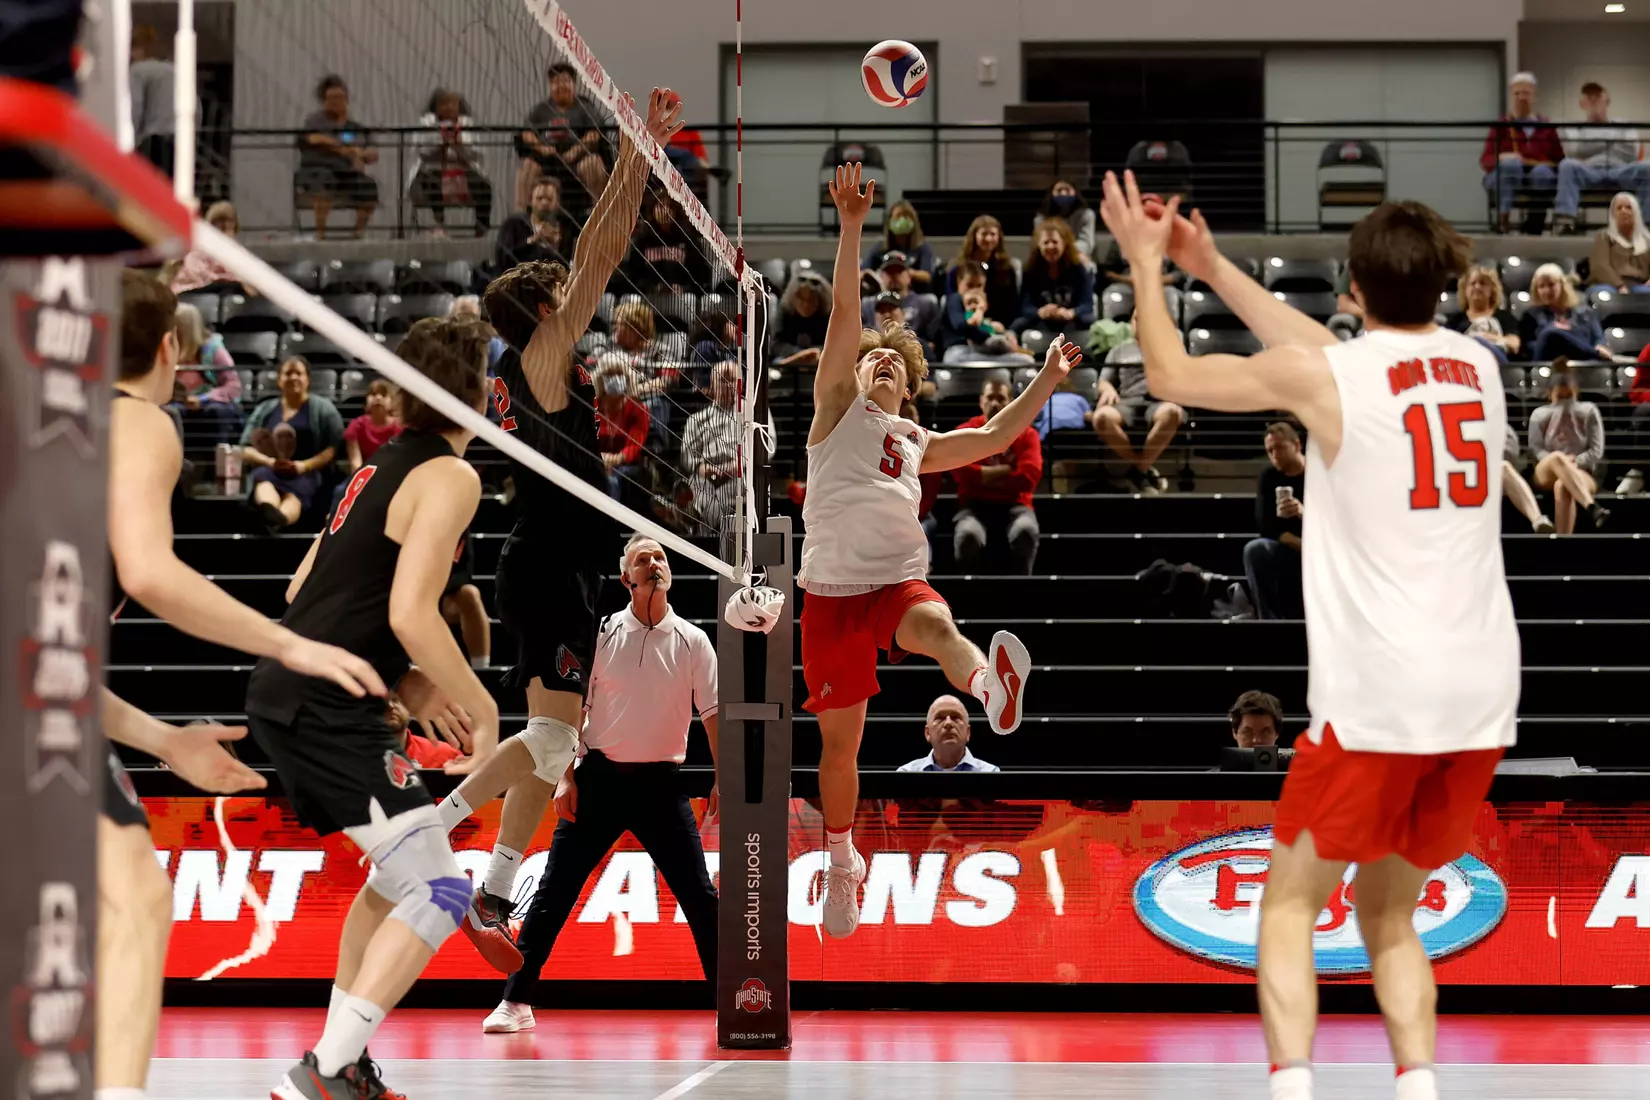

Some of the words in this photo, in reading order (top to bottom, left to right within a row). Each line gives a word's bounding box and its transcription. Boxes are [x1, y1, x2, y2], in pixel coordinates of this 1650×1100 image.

[879, 432, 904, 479] 5
[1402, 401, 1488, 510] 15
[329, 465, 378, 535] 8
[154, 850, 327, 921] NT
[744, 832, 762, 889] sports
[744, 892, 762, 961] imports
